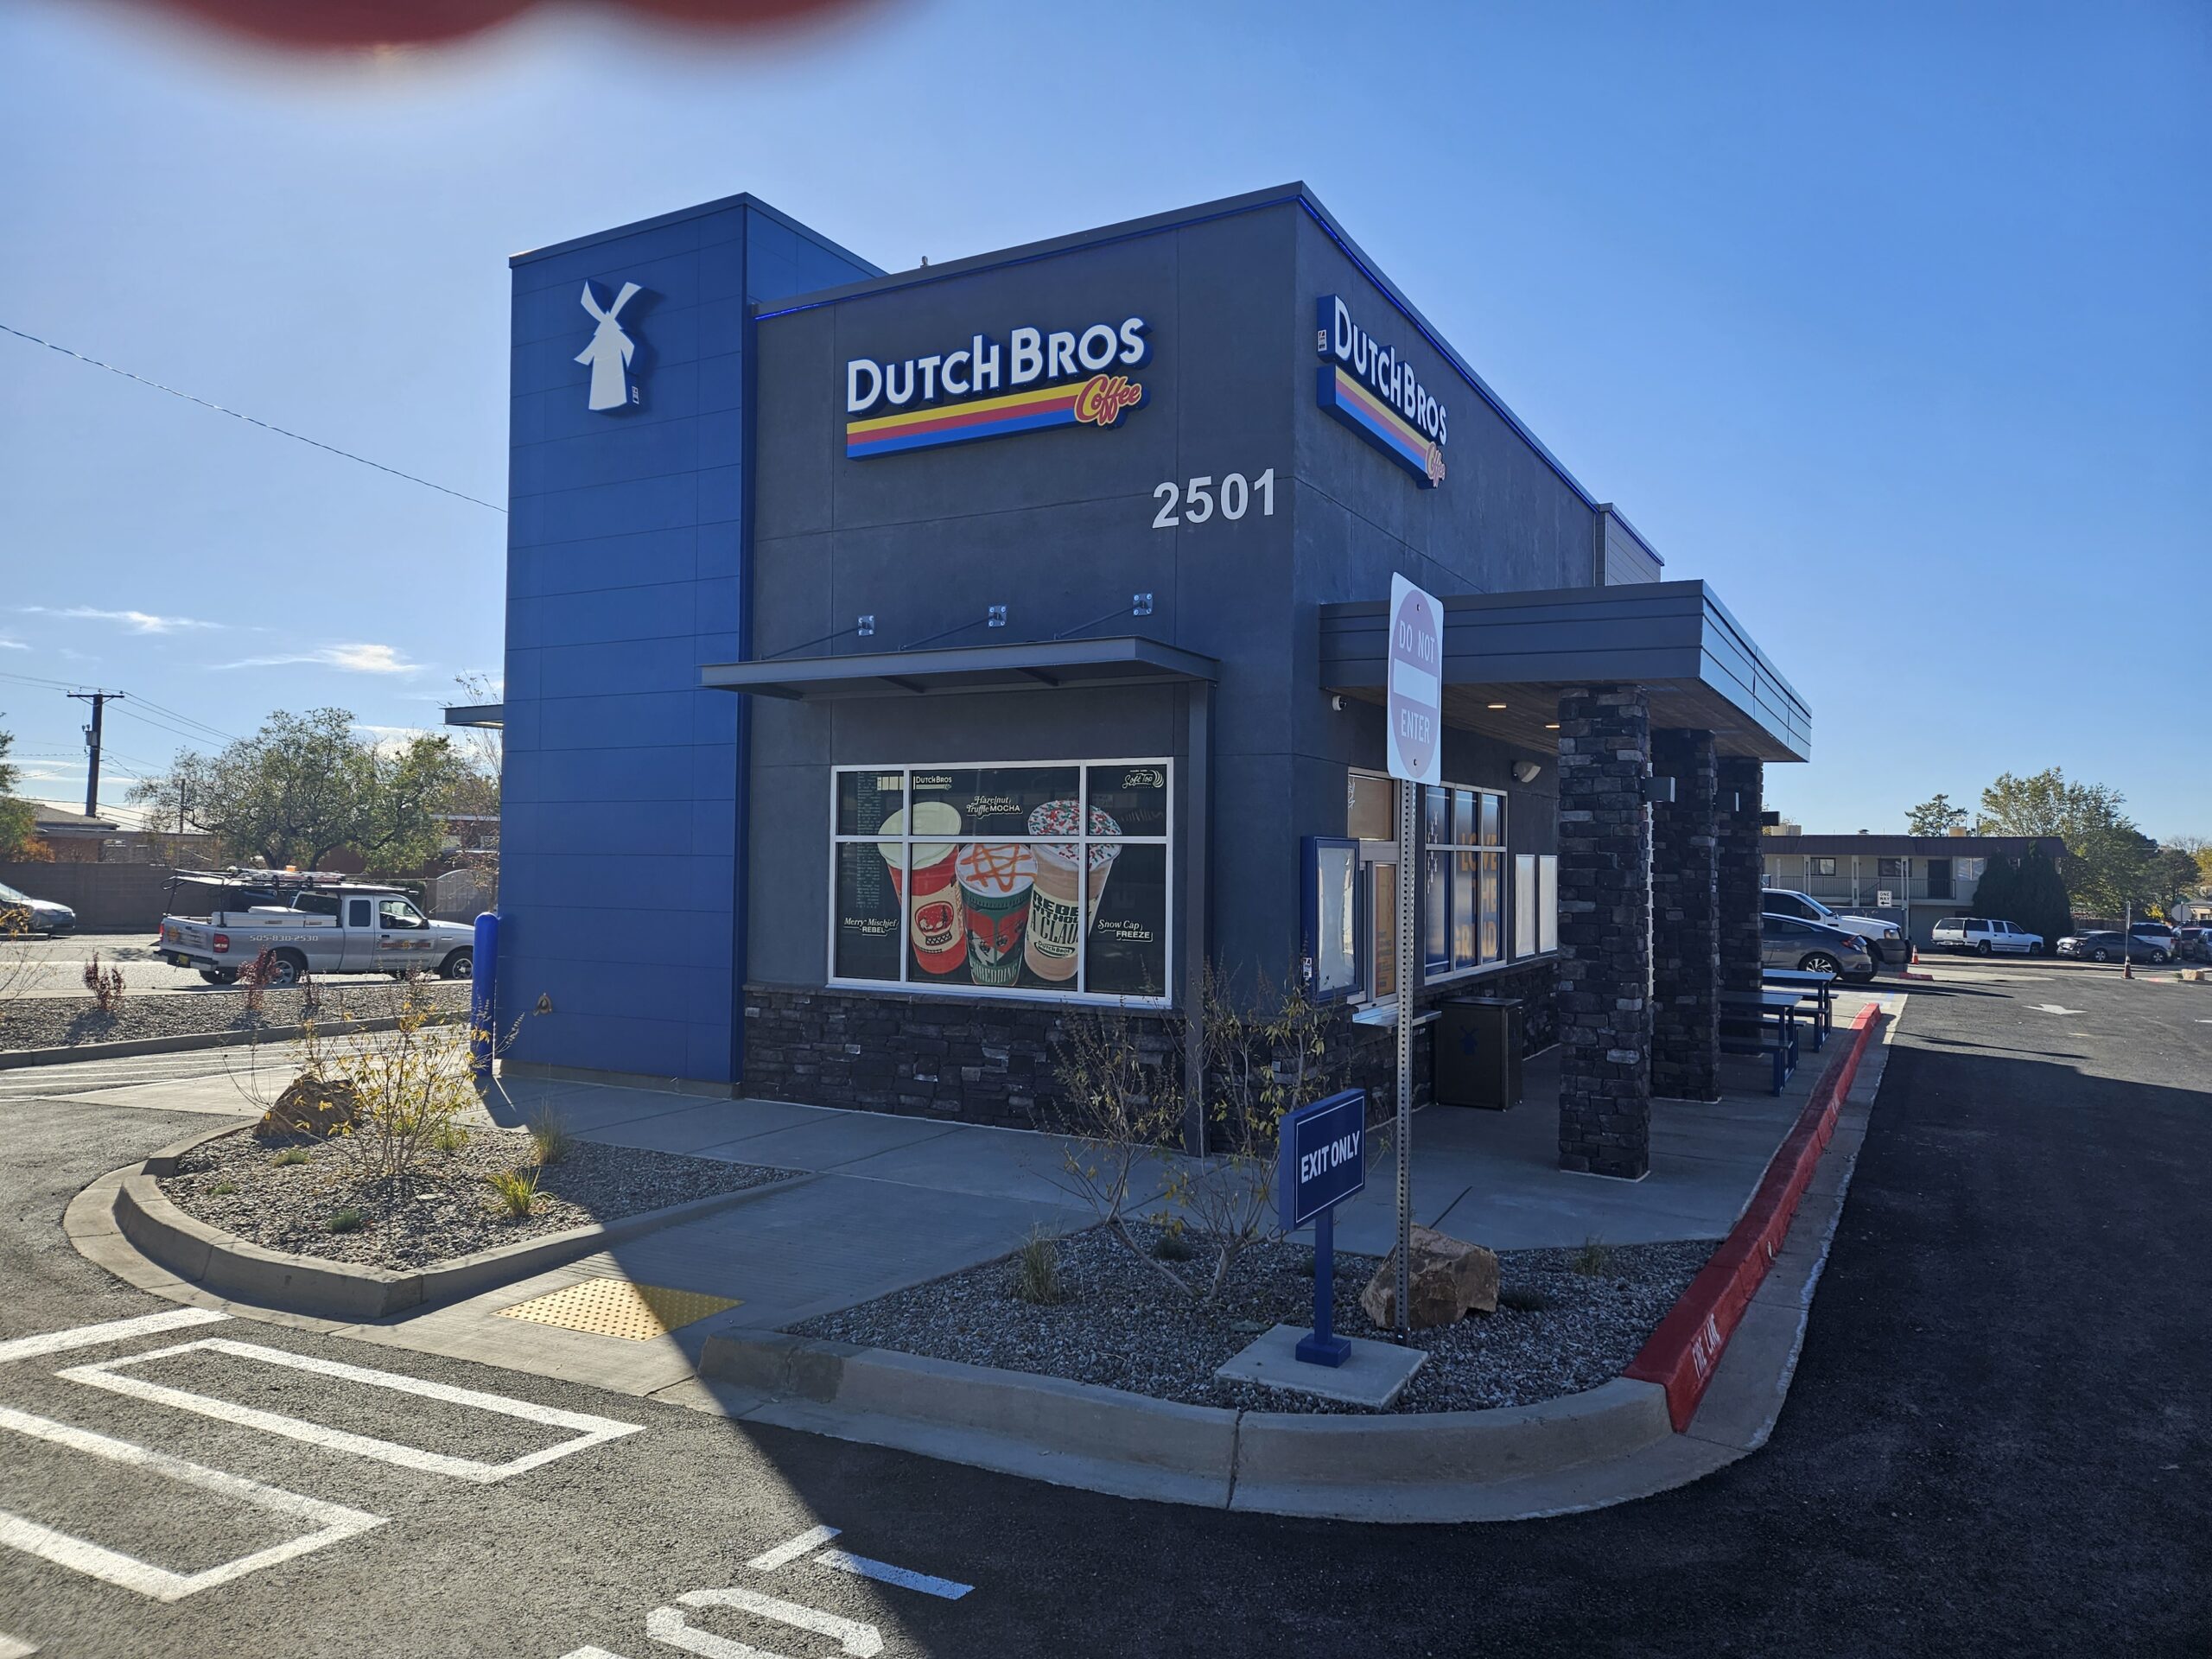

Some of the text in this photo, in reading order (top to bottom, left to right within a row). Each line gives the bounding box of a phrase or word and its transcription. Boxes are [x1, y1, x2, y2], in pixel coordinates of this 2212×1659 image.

[847, 317, 1145, 413] DUTCH BROS
[1334, 294, 1447, 447] DUTCH BROS
[1075, 374, 1142, 426] Coffee
[1152, 468, 1274, 529] 2501
[1399, 620, 1435, 664] DO NOT
[1401, 709, 1430, 744] ENTER
[974, 796, 1009, 805] Hazelnut
[1033, 890, 1079, 916] REBE
[1033, 900, 1079, 924] WITHOU
[844, 918, 897, 928] Merry Mischief
[1040, 917, 1079, 944] CLAU
[1097, 919, 1140, 931] Snow Cap
[1301, 1130, 1360, 1184] EXIT ONLY
